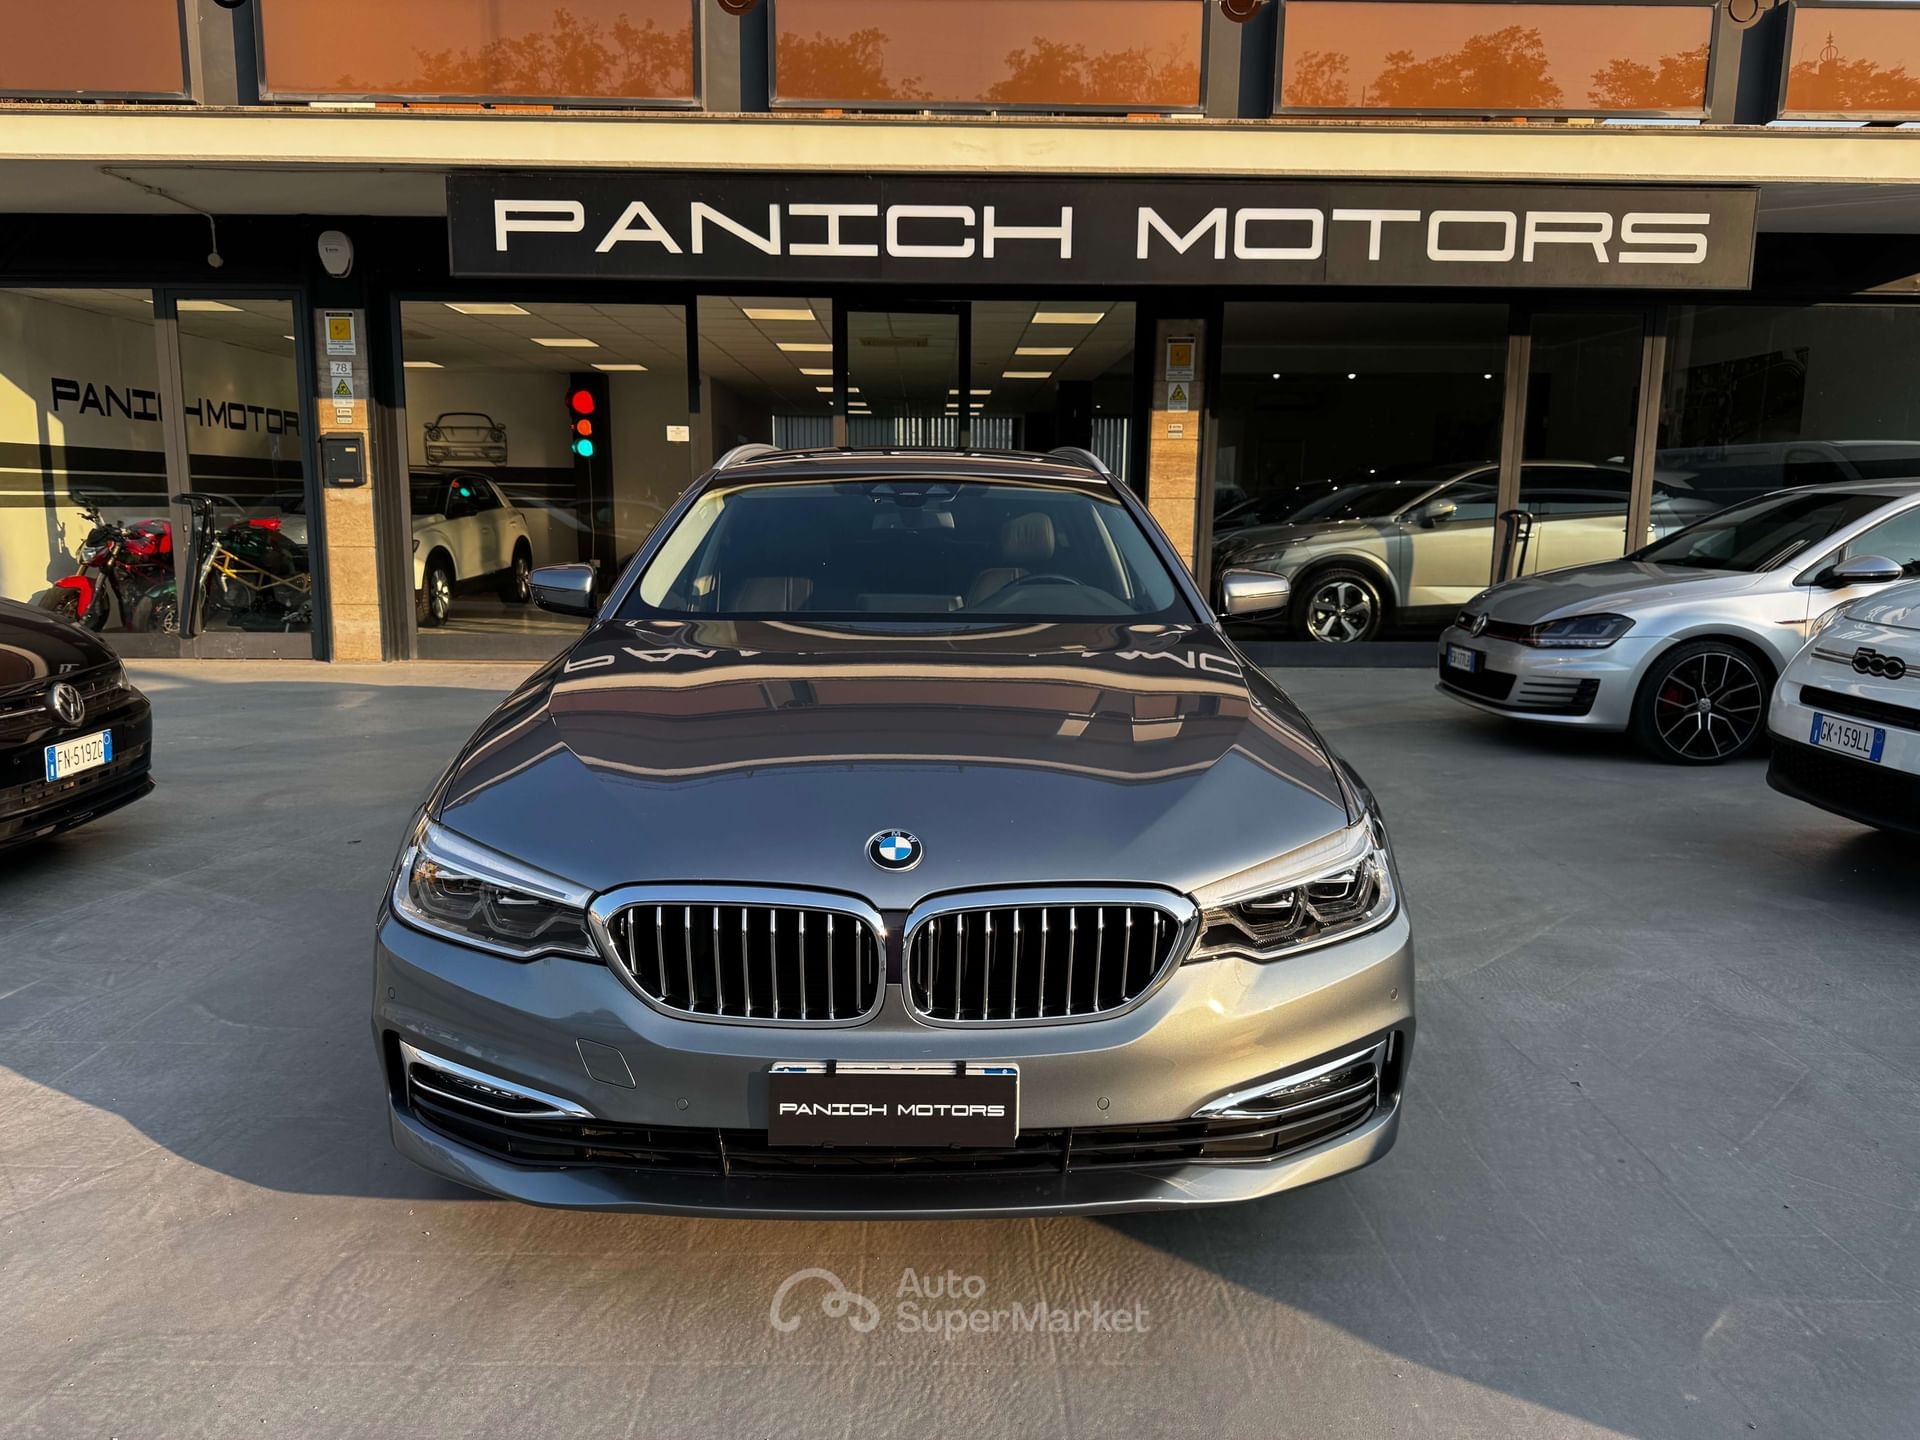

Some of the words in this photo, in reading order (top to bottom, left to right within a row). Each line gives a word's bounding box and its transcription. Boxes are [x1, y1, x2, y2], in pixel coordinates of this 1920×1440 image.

[494, 199, 1073, 260] PANICH
[1136, 206, 1711, 265] MOTORS
[335, 363, 348, 372] 78
[51, 377, 203, 427] PANIH
[1852, 647, 1906, 680] 500
[779, 1103, 887, 1116] PANICH
[897, 1104, 1005, 1117] MOTORS
